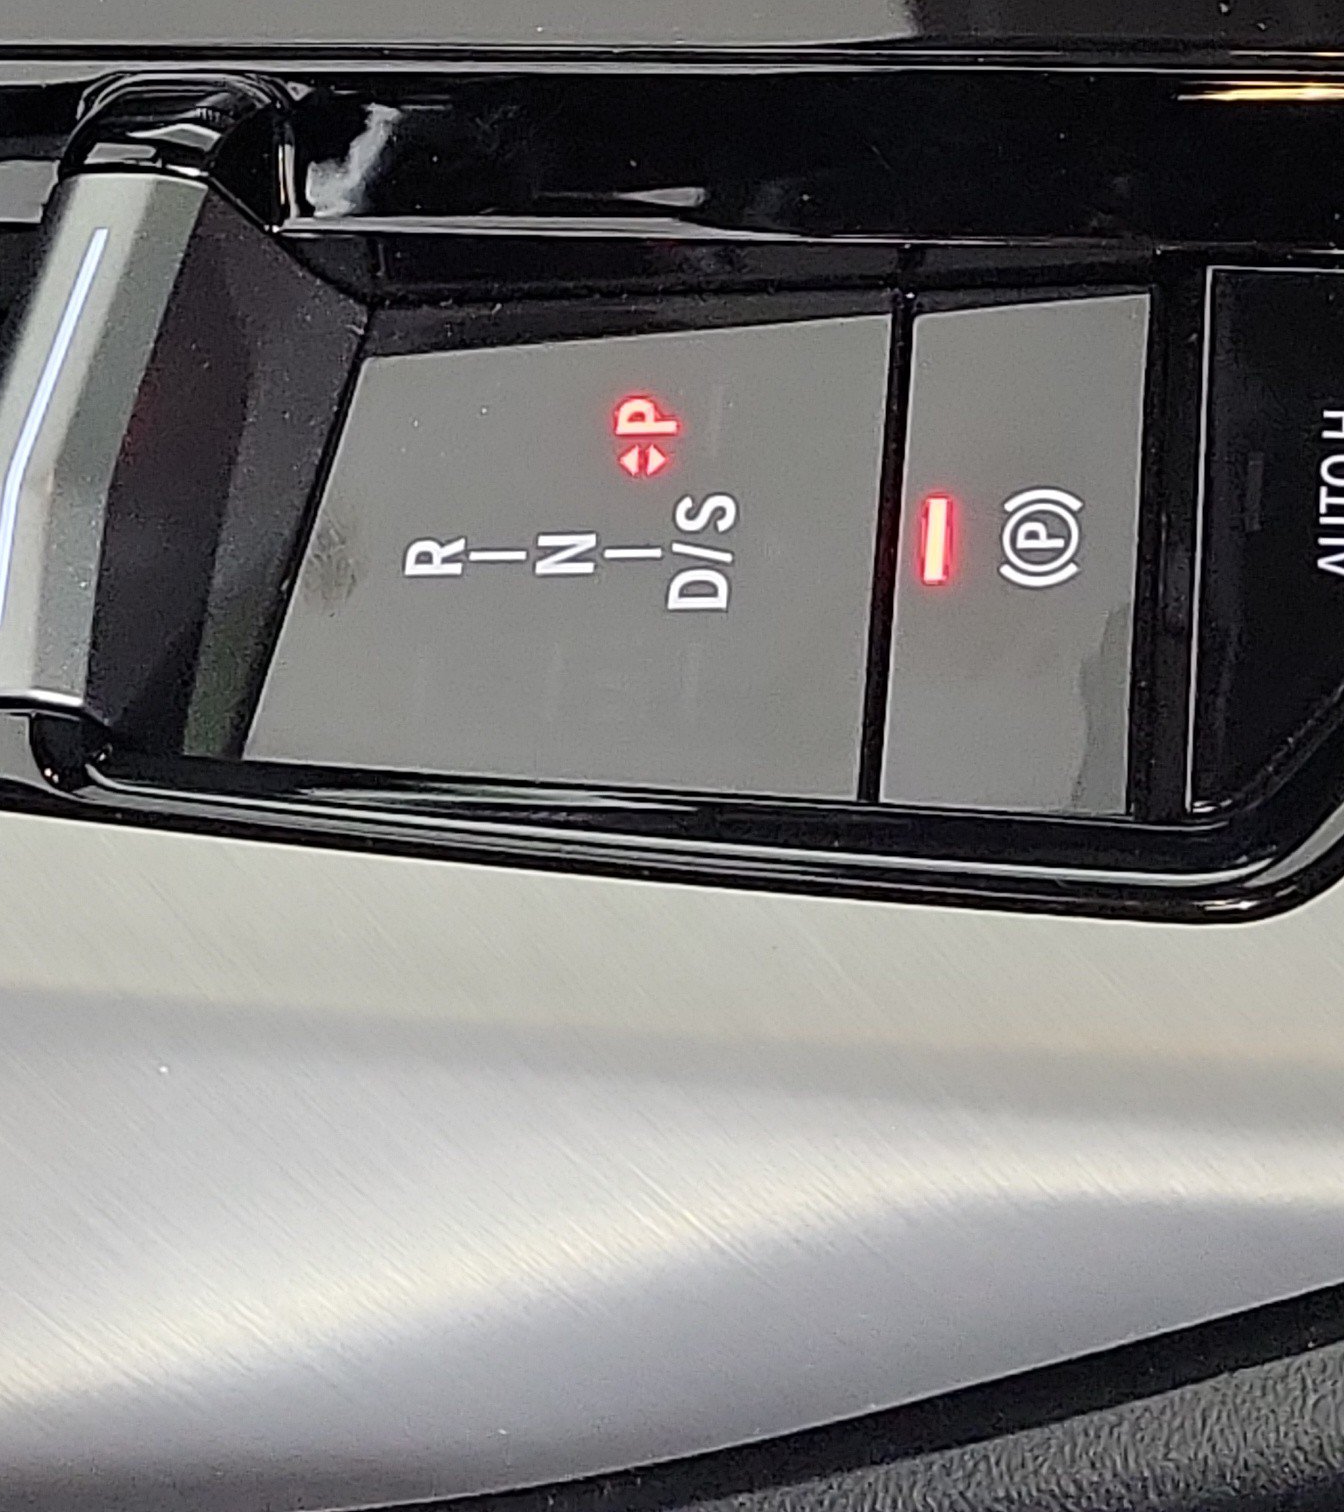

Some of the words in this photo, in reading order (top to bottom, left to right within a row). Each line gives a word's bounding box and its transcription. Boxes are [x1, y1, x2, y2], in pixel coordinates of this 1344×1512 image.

[615, 397, 678, 435] P
[403, 537, 466, 576] R
[535, 532, 597, 575] N
[667, 492, 738, 610] D/S
